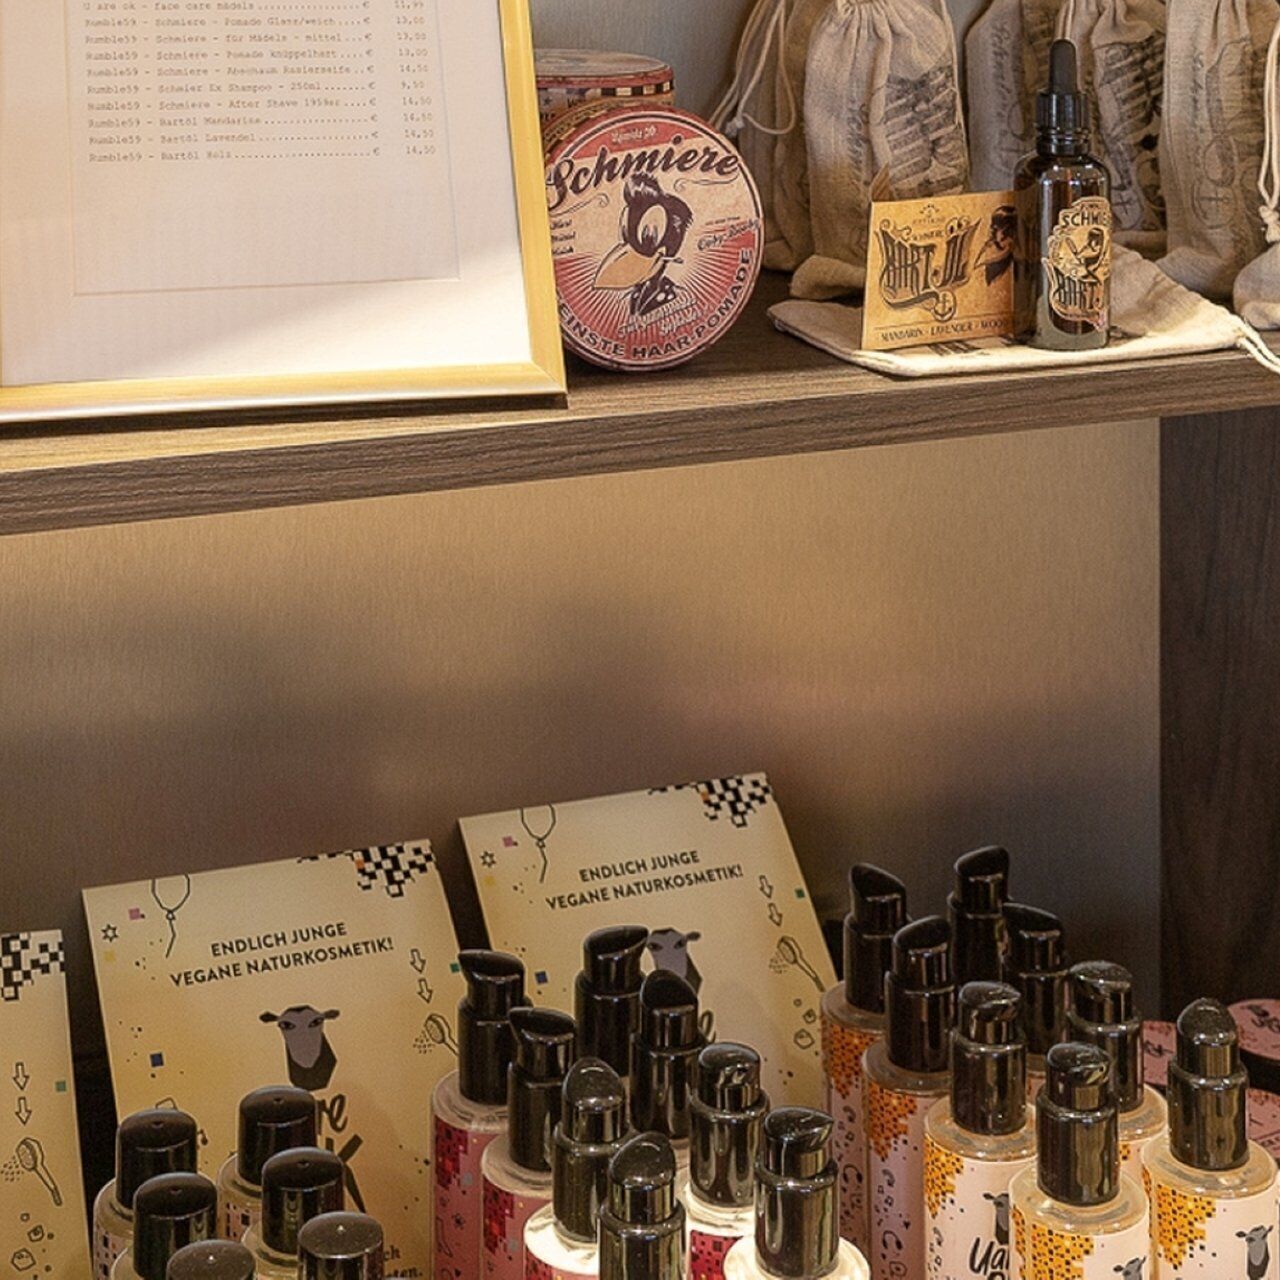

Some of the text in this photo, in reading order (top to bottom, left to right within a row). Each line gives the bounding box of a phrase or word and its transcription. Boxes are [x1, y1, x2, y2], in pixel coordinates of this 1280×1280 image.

[547, 135, 740, 211] Schmiere
[558, 248, 755, 361] EINSTE HAAR-POMADE
[546, 864, 744, 910] VEGANE NATURKOSMETIK!
[579, 850, 700, 883] ENDLICH JUNGE
[170, 936, 394, 987] VEGANE NATURKOSMETIK!
[211, 922, 347, 957] ENDLICH JUNGE
